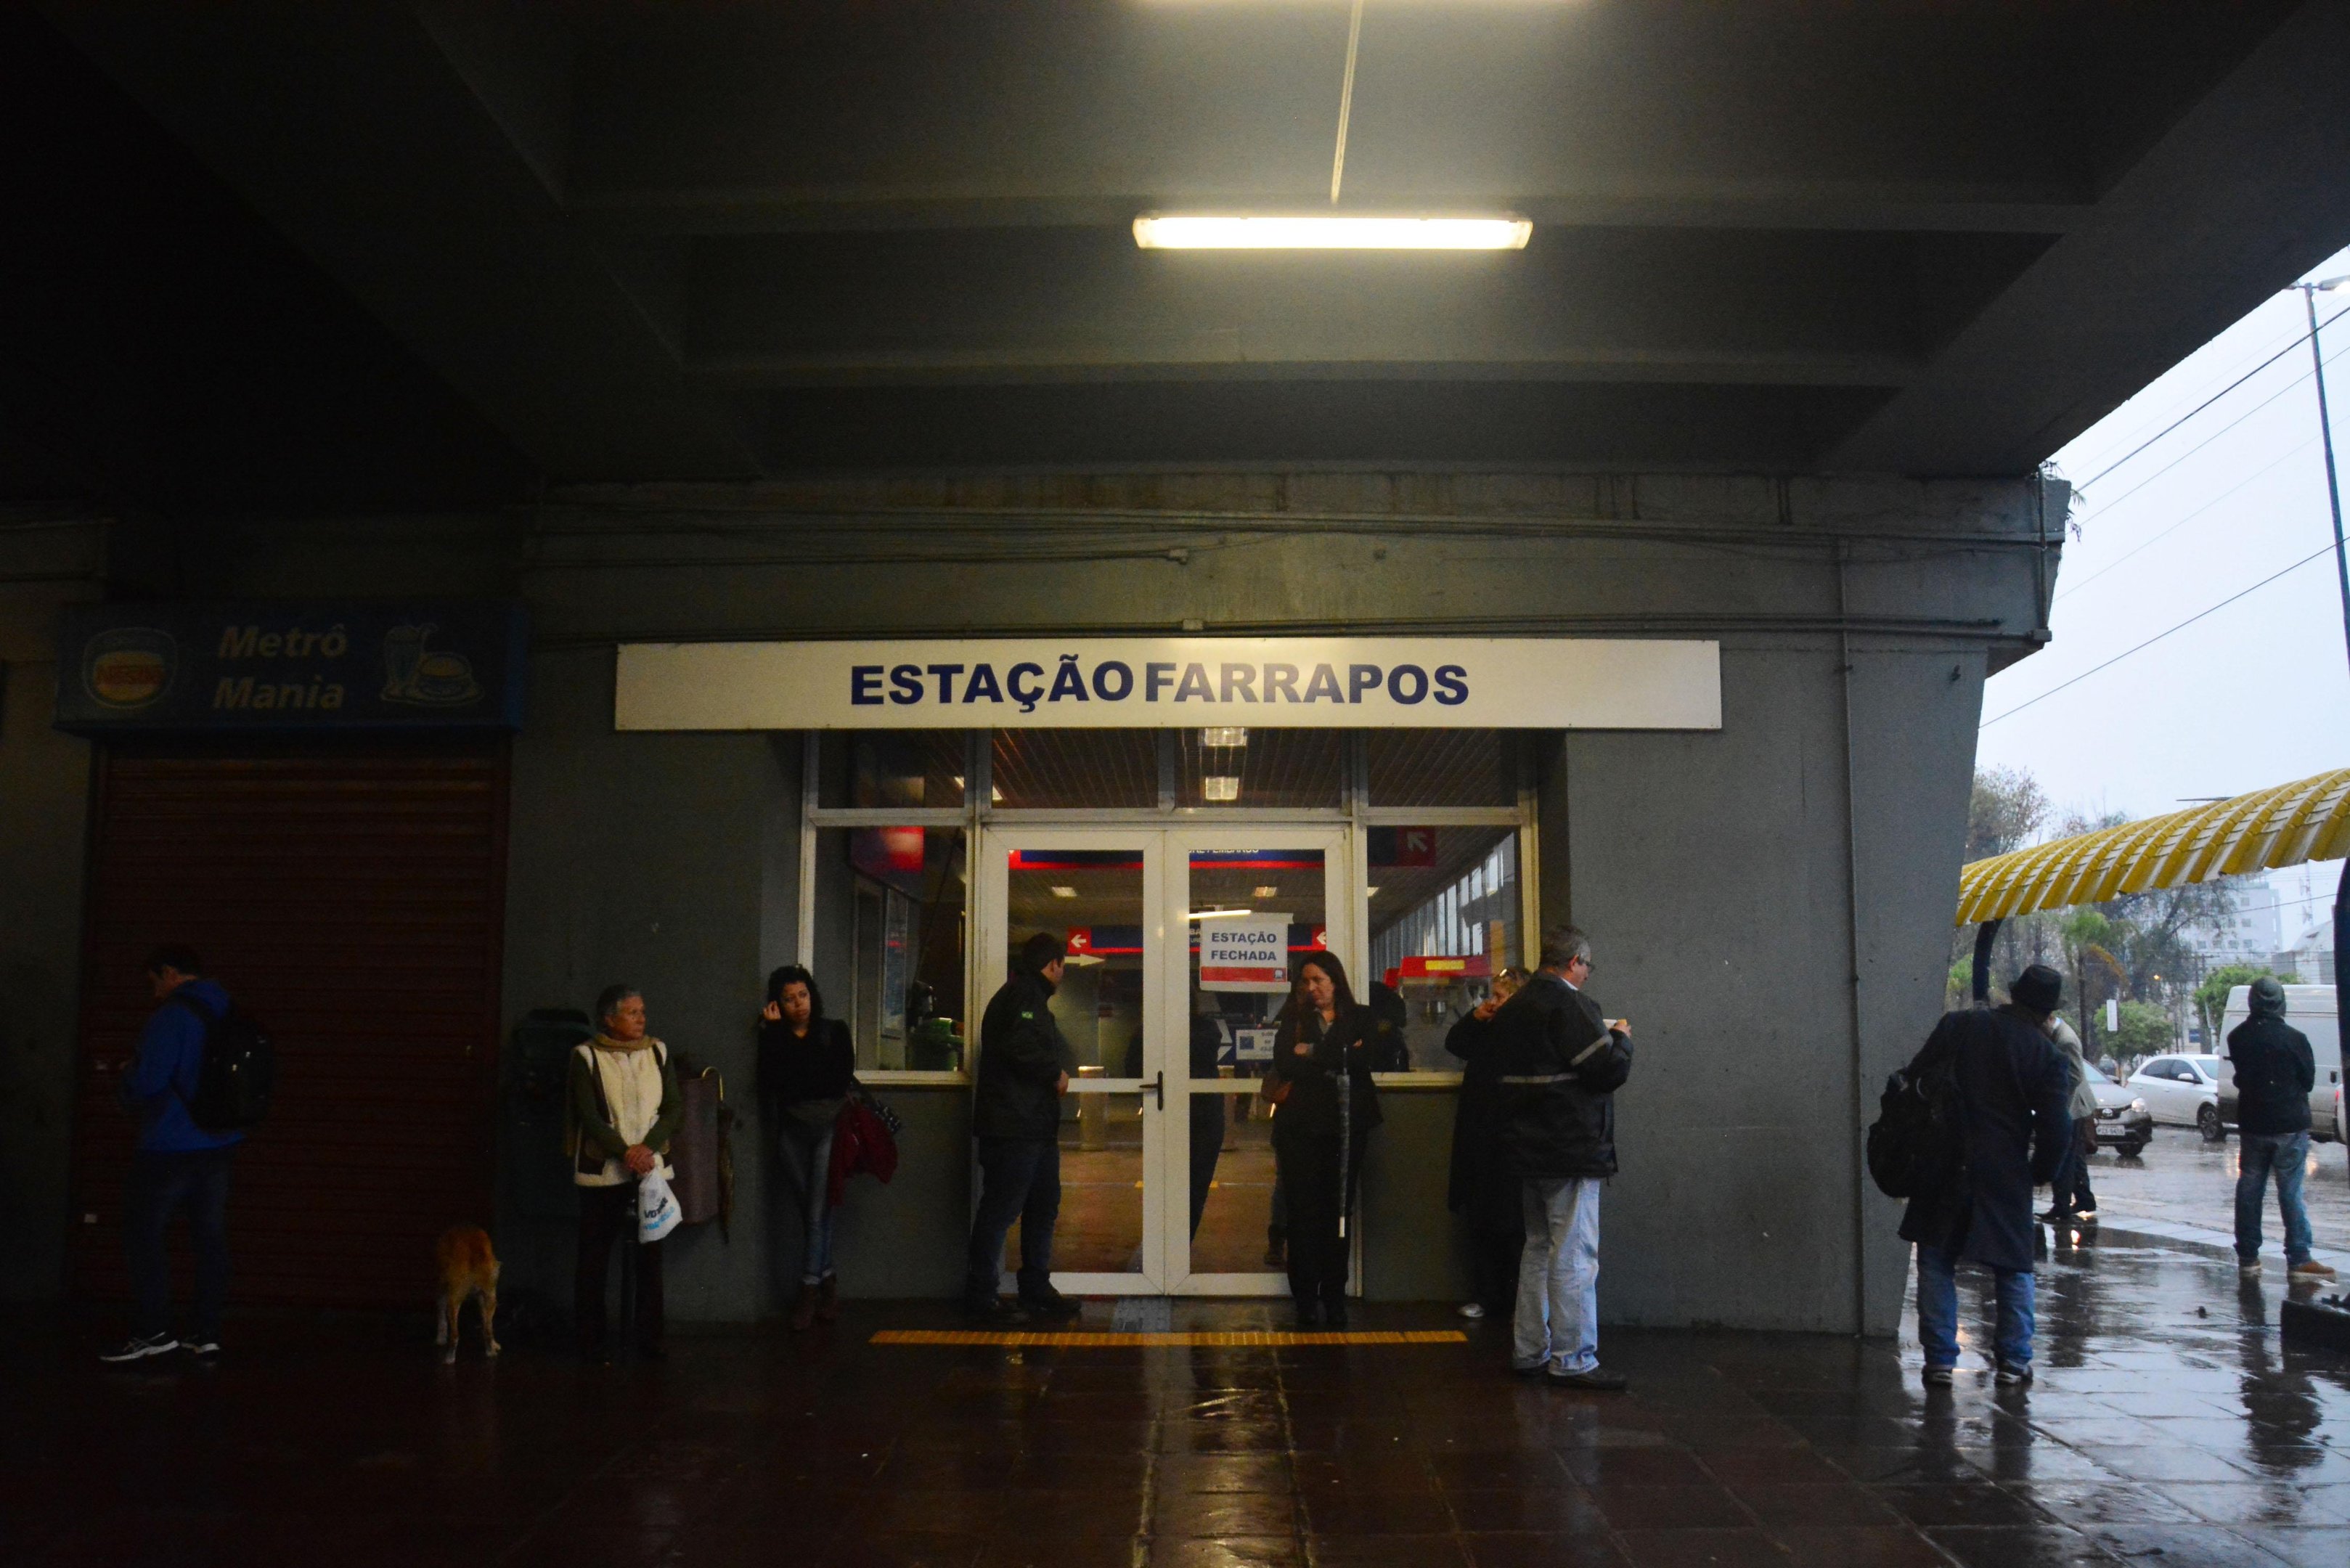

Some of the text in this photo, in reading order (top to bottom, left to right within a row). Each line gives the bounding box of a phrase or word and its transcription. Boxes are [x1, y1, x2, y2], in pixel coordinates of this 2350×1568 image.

[219, 623, 349, 659] Metrô
[212, 674, 345, 711] Mania
[851, 653, 1469, 713] ESTAÇÃO FARRAPOS
[1210, 950, 1278, 961] FECHADA
[1211, 931, 1277, 945] ESTAÇÃO
